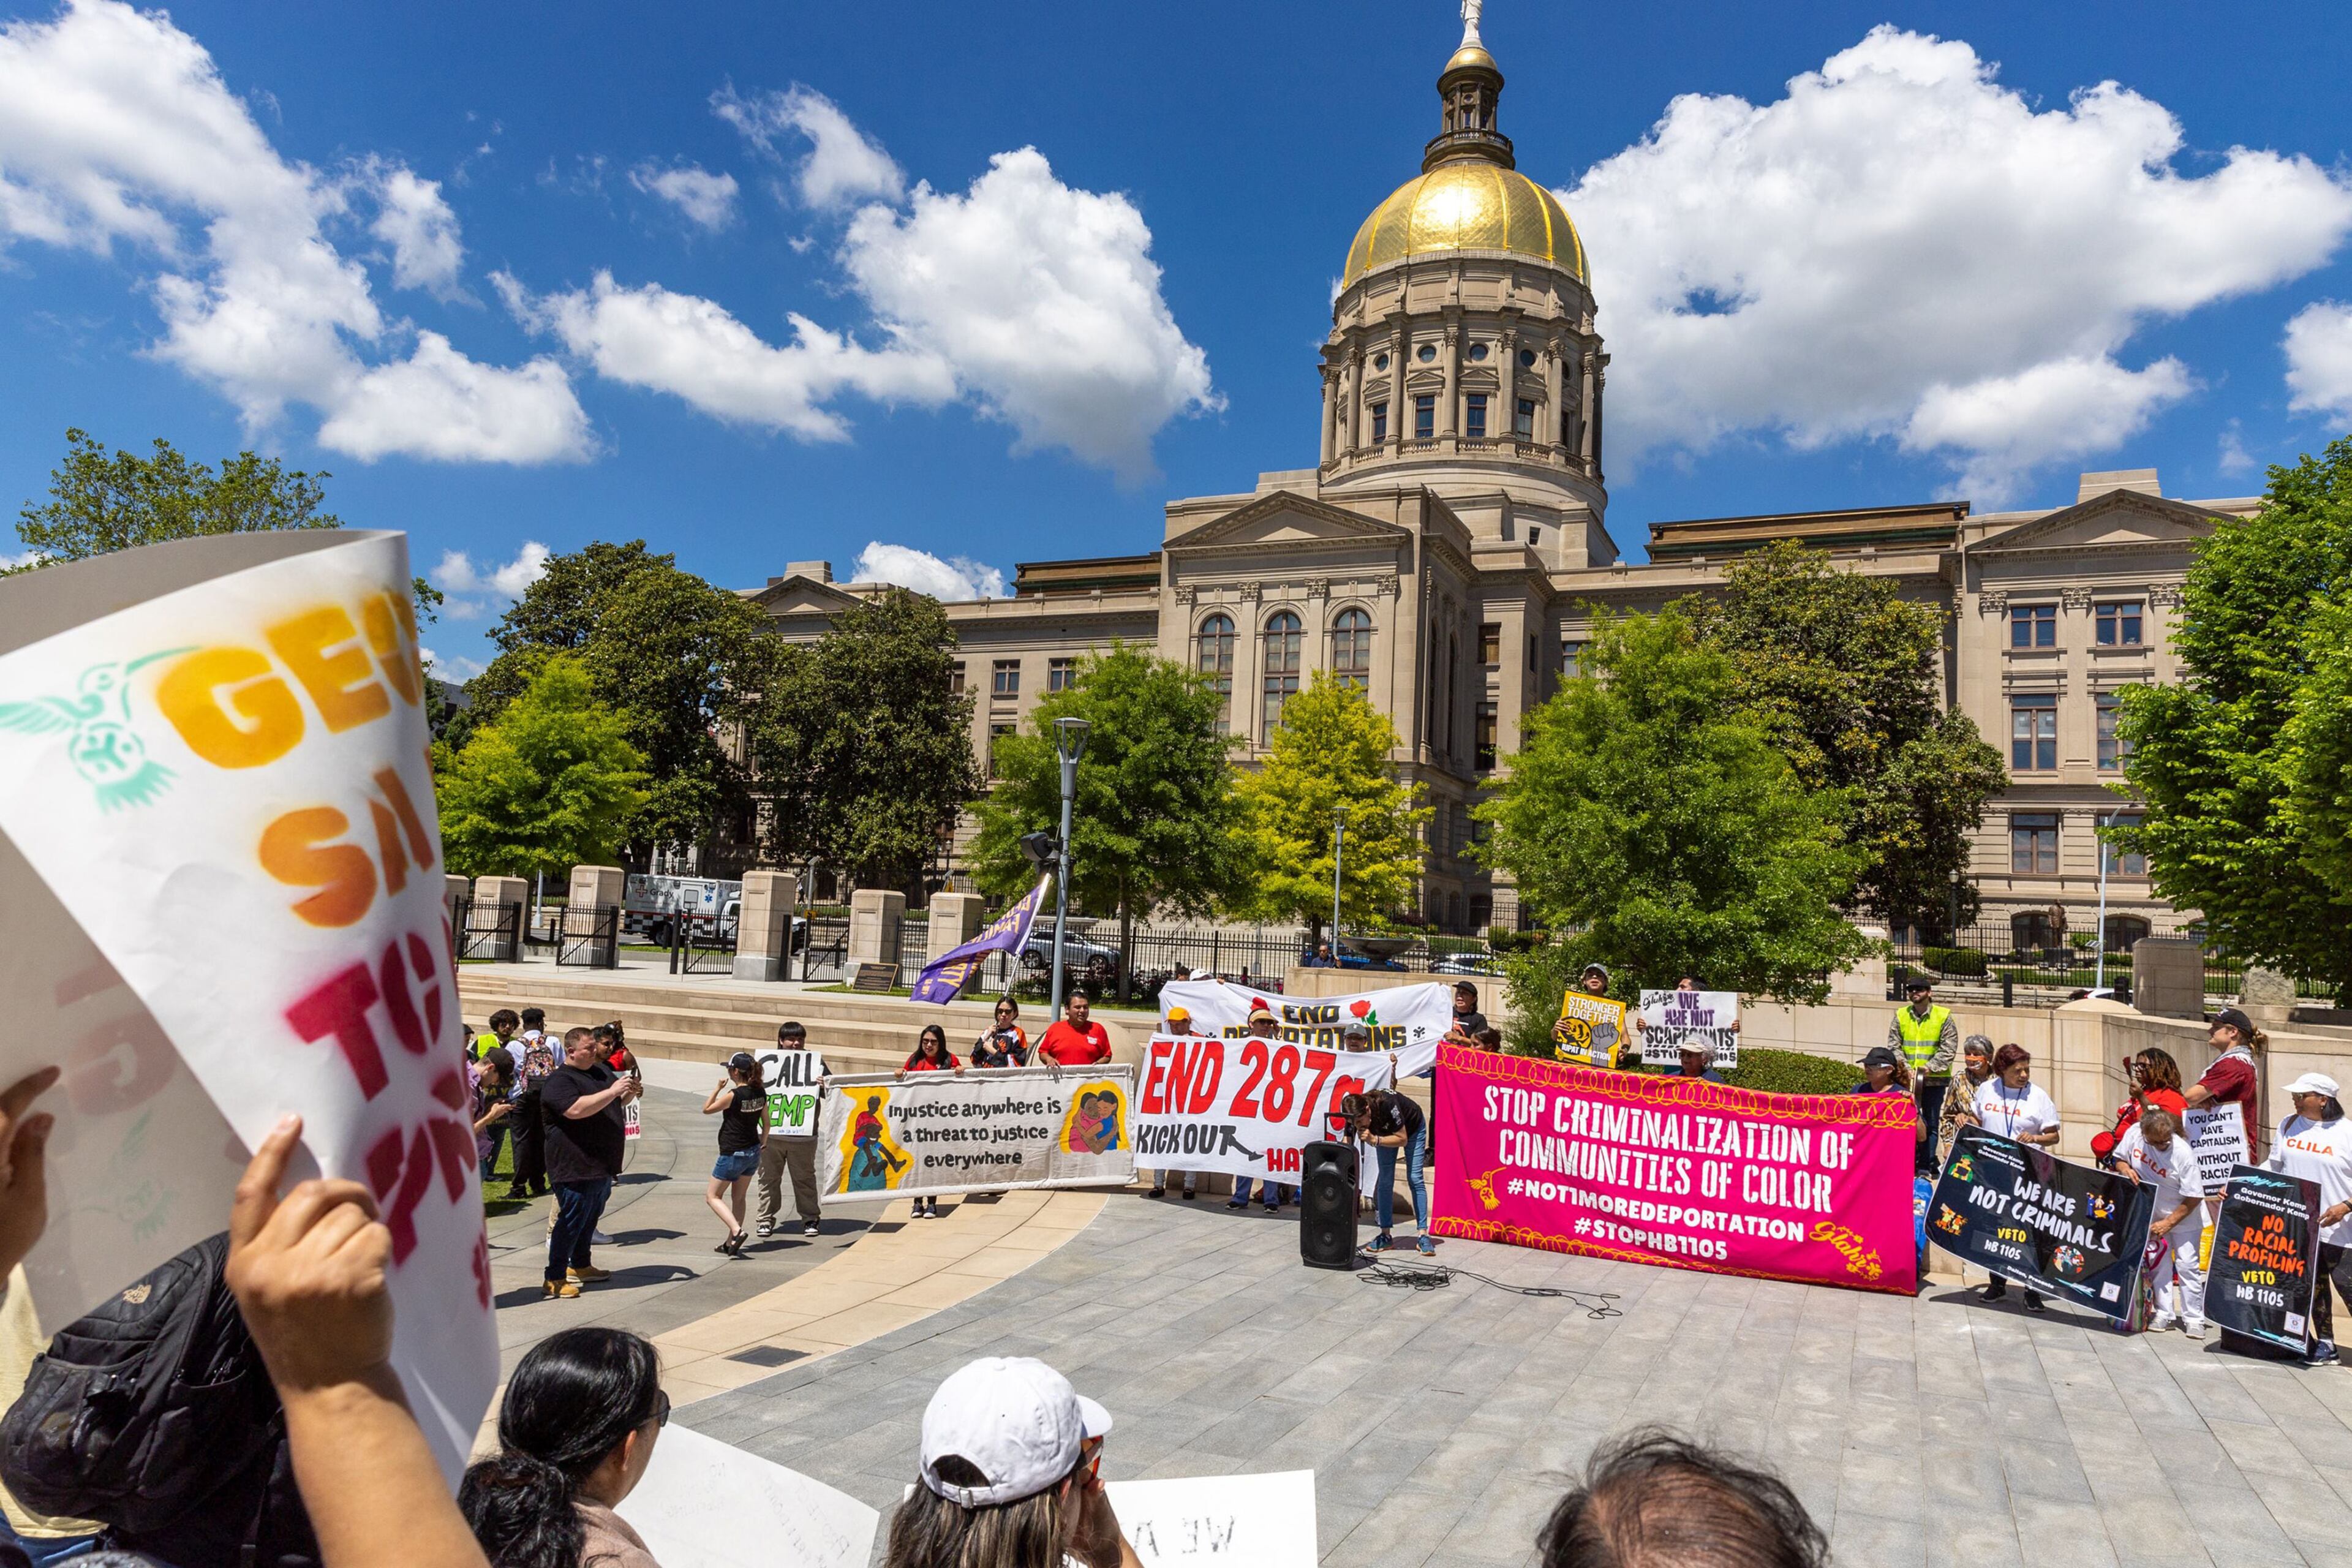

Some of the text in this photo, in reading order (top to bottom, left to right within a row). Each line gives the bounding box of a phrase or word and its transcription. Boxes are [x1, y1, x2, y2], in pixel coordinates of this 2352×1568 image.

[650, 889, 674, 899] Grady
[1569, 996, 1620, 1016] STRONGER
[1678, 992, 1699, 1009] WE
[1281, 1004, 1341, 1025] END
[1568, 1006, 1618, 1026] TOGETHER
[1665, 1009, 1714, 1027] ARE NOT
[1561, 1043, 1580, 1054] IUPAT
[1588, 1050, 1611, 1061] ACTION
[758, 1053, 816, 1088] CALL
[1140, 1041, 1365, 1131] END 287g
[758, 1093, 815, 1127] EMP
[888, 1097, 1061, 1122] Injustice anywhere is
[1985, 1102, 2021, 1117] CLILA
[2188, 1112, 2234, 1125] YOU CAN'T
[903, 1125, 1048, 1144] a threat to justice
[1483, 1084, 1854, 1170] STOP CRIMINALIZATION OF
[2201, 1125, 2223, 1135] HAVE
[2190, 1136, 2240, 1148] CAPITALISM
[2287, 1138, 2333, 1156] CLILA
[924, 1152, 1023, 1169] everywhere
[1978, 1148, 2026, 1172] Gobernador Kemp
[1983, 1145, 2024, 1166] Governor Kemp
[2133, 1148, 2166, 1178] CLILA
[1499, 1129, 1832, 1213] COMMUNITIES OF COLOR
[2201, 1167, 2230, 1180] RACIS
[2013, 1176, 2076, 1216] WE ARE
[2234, 1193, 2310, 1220] Gobernador Kemp
[2241, 1187, 2307, 1211] Governor Kemp
[1507, 1178, 1804, 1242] #NOT1MOREDEPORTATION
[1969, 1185, 2114, 1253] NOT CRIMINALS
[2262, 1215, 2284, 1233] NO
[1574, 1217, 1728, 1260] #STOPHB1105
[1997, 1227, 2027, 1243] VETO
[2243, 1226, 2296, 1255] RACIAL
[1985, 1239, 2022, 1260] HB 1105
[2228, 1240, 2305, 1278] PROFILING
[2242, 1270, 2275, 1285] VETO
[2236, 1284, 2284, 1307] HB 1105
